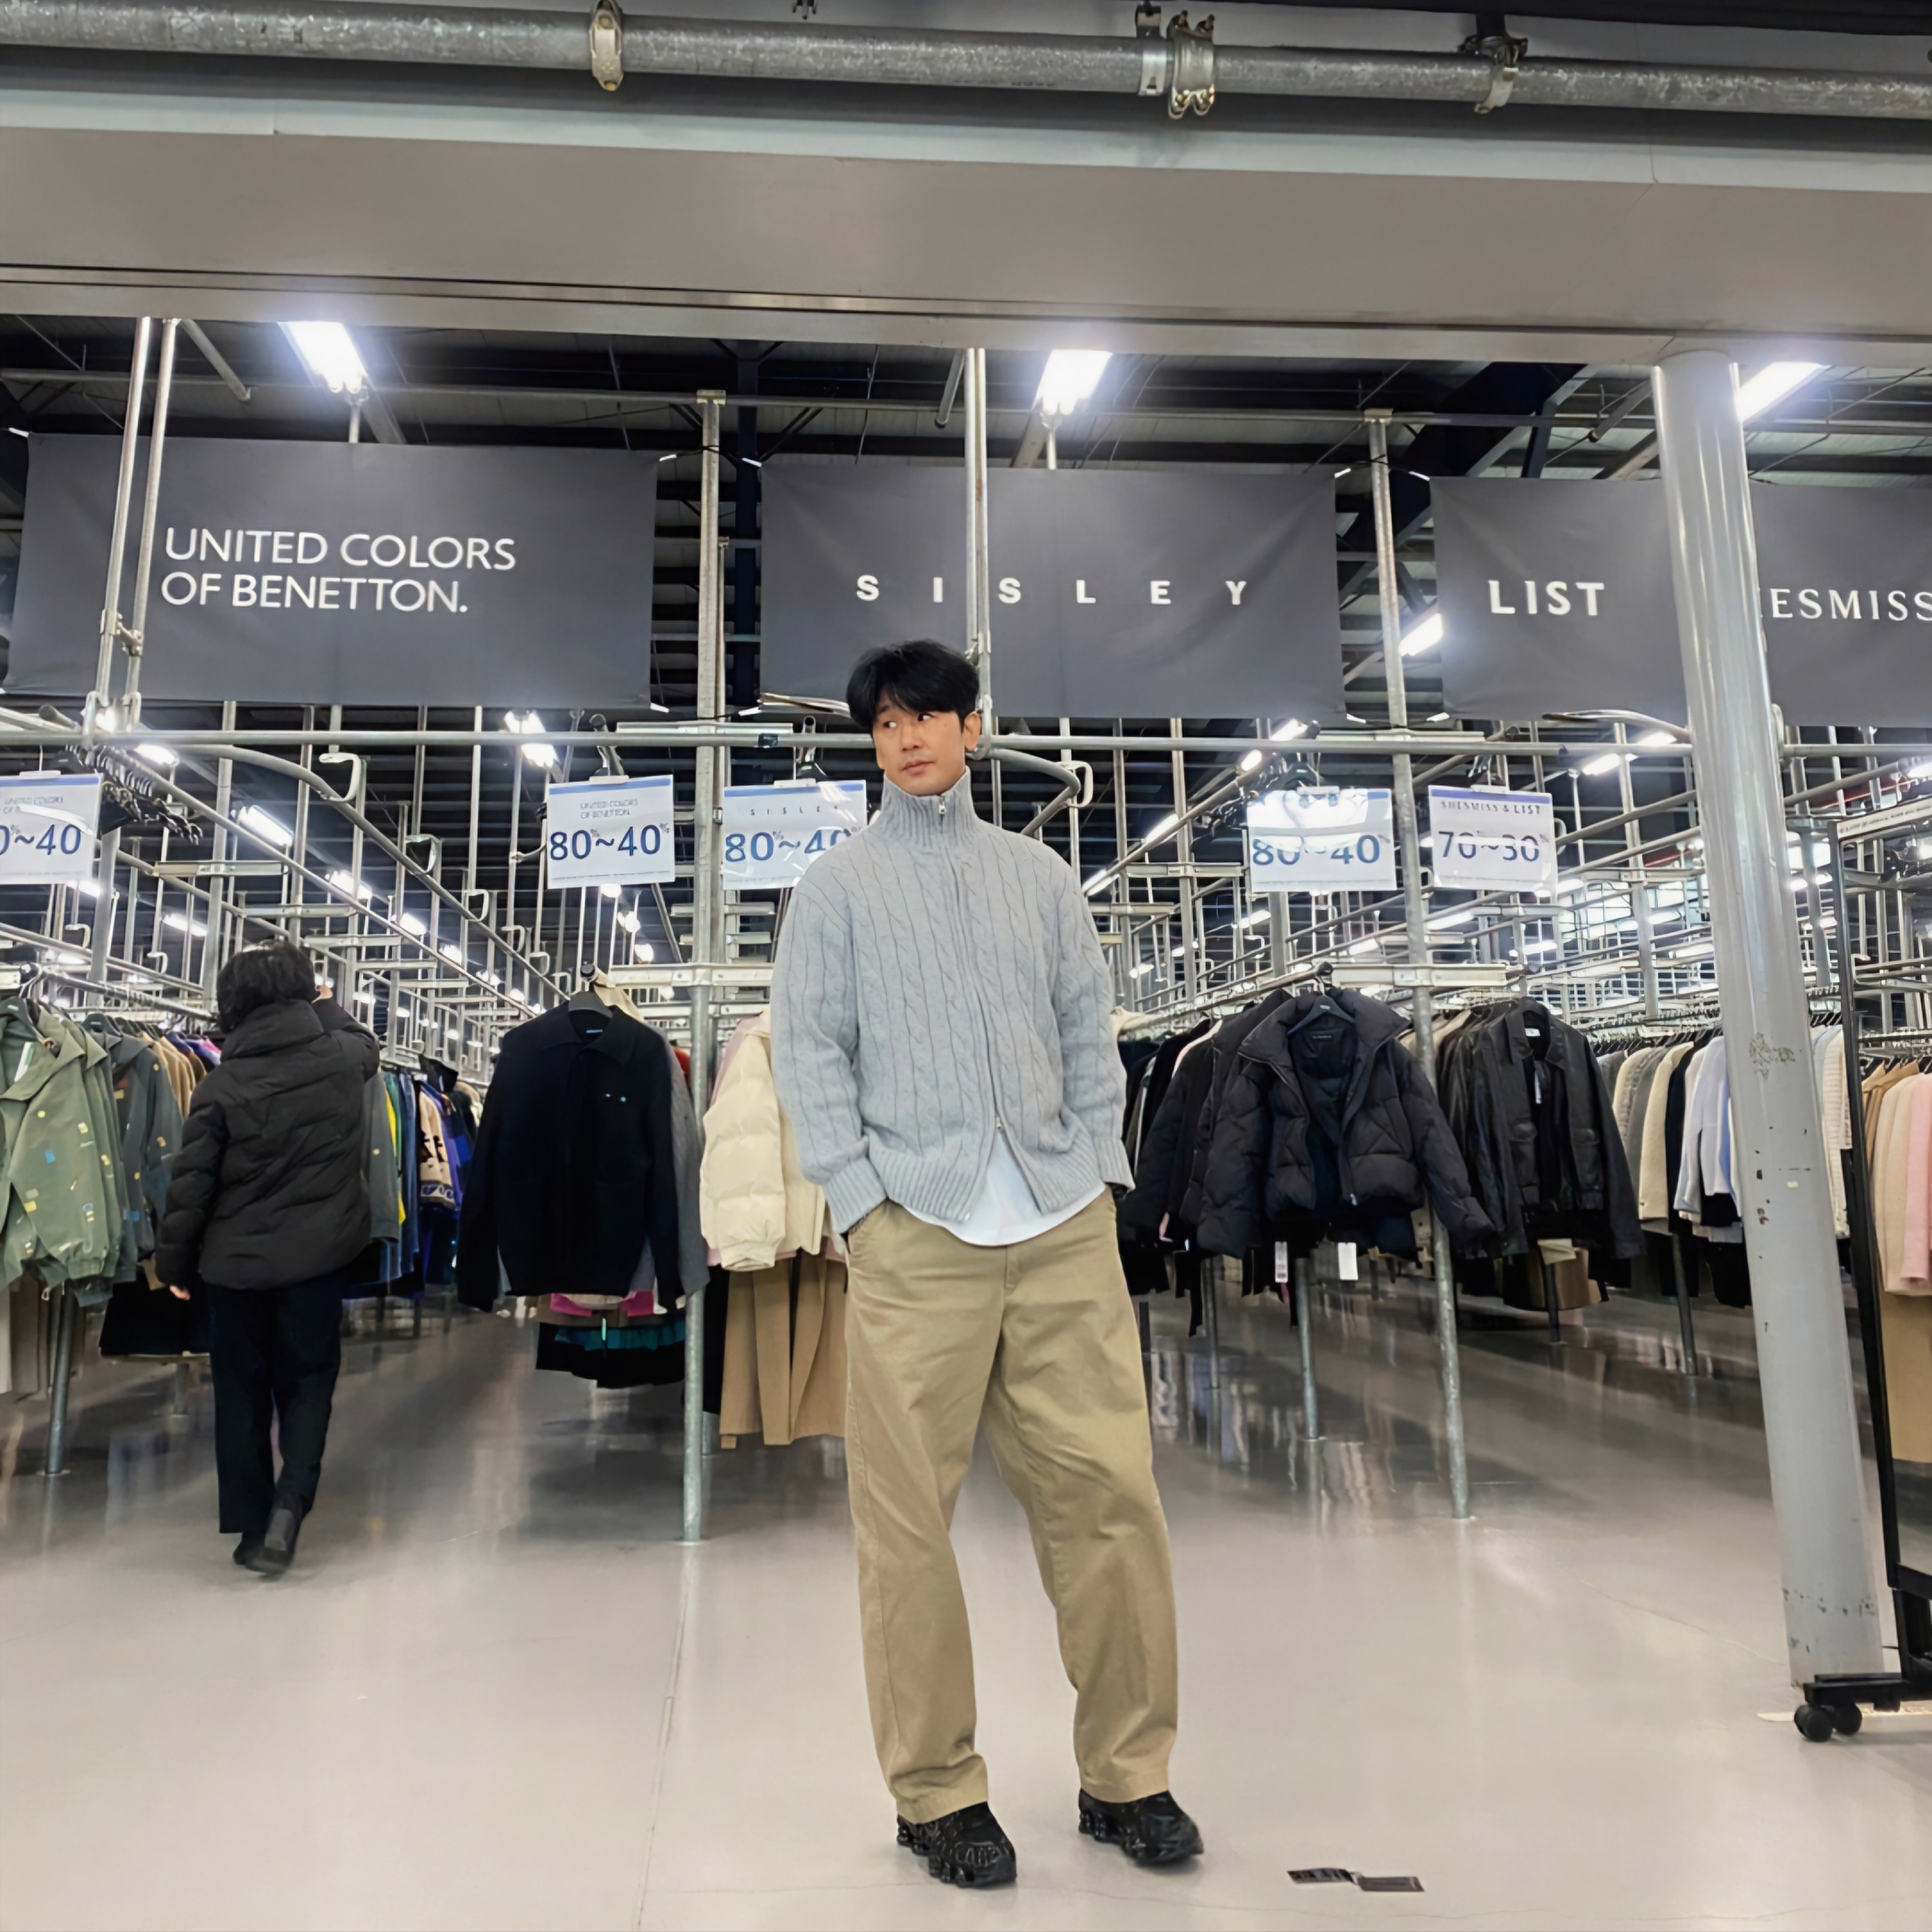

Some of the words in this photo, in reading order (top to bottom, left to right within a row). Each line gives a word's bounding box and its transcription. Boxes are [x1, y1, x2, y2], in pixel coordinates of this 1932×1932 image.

[165, 526, 328, 564] UNITED
[340, 533, 516, 571] COLORS
[160, 571, 222, 606] OF
[231, 574, 468, 613] BENETTON.
[856, 574, 1247, 606] SISLEY
[1487, 579, 1605, 616] LIST
[1762, 588, 1932, 621] ESMISS
[1514, 804, 1541, 815] LIST
